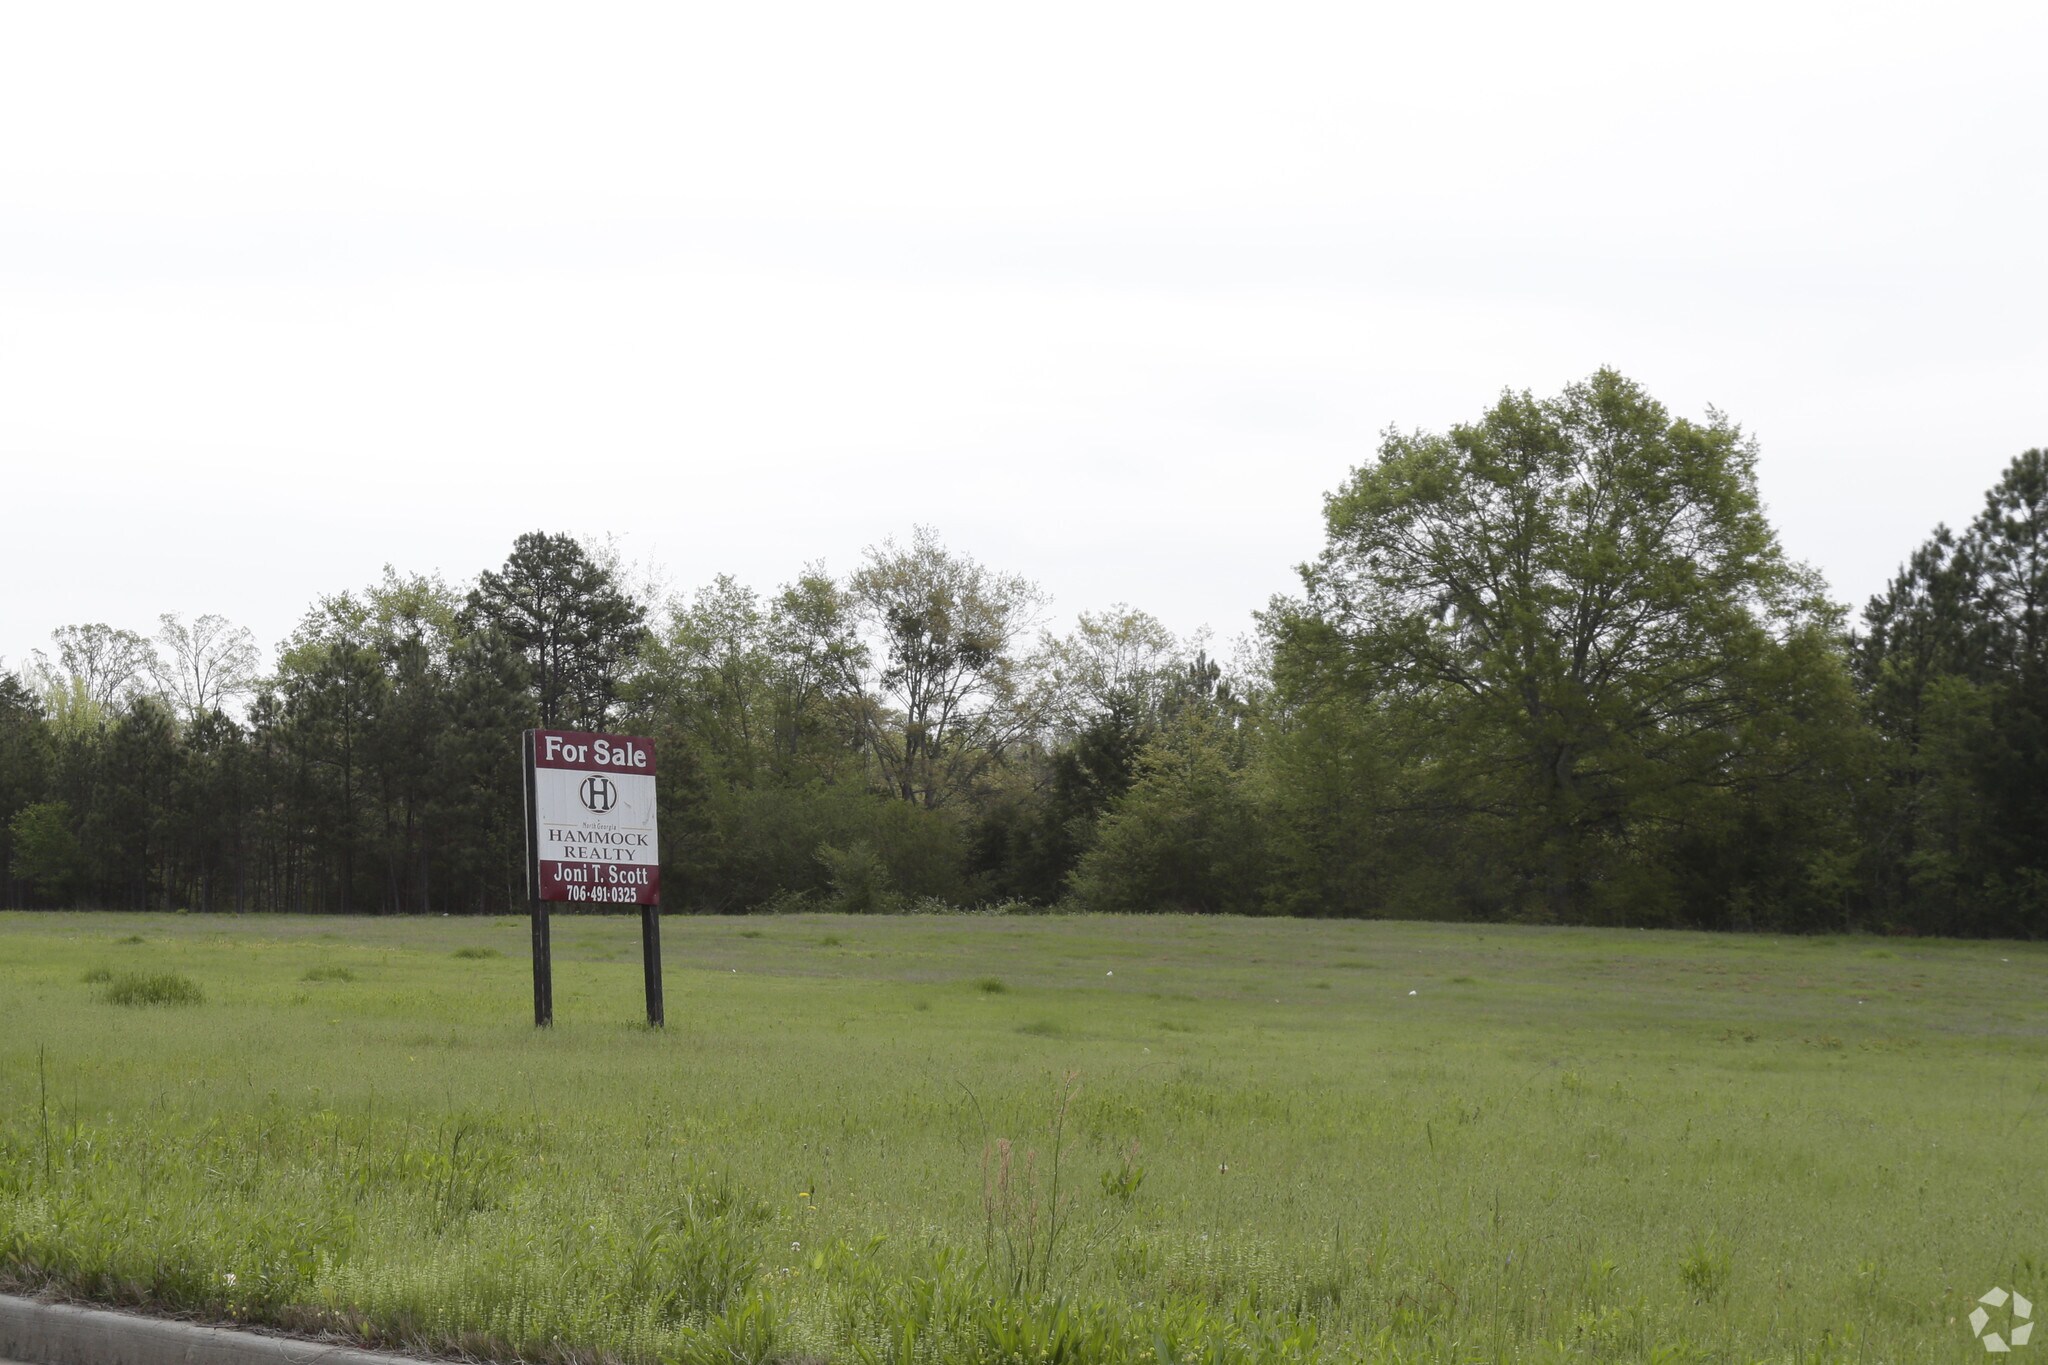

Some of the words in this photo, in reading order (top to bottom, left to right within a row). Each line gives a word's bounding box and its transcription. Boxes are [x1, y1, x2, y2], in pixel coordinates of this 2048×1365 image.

[545, 735, 588, 763] For
[593, 739, 647, 768] Sale
[548, 828, 649, 847] HAMMOCK
[564, 845, 636, 861] REALTY
[553, 862, 588, 882] Joni
[591, 864, 604, 883] T.
[608, 865, 649, 885] Scott
